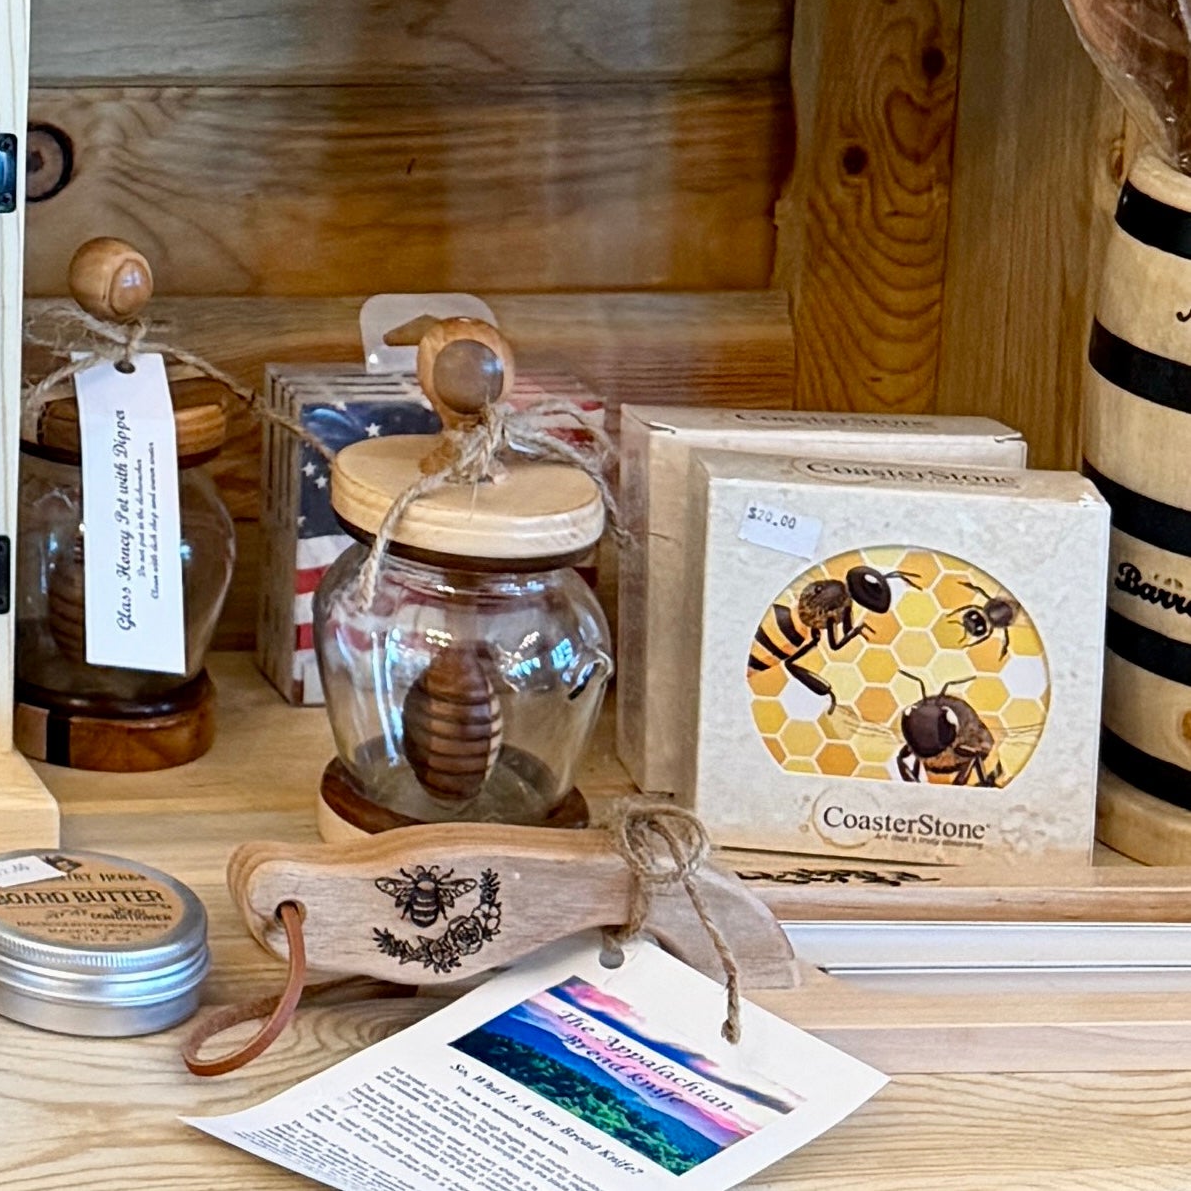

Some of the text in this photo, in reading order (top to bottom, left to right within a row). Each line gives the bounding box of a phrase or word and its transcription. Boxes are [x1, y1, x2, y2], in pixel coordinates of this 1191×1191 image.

[114, 463, 128, 494] with
[806, 462, 1018, 485] CoasterStone
[114, 498, 130, 525] Pot
[747, 506, 796, 530] $20.00
[116, 530, 134, 580] Honey
[1114, 562, 1191, 618] Barr
[116, 587, 136, 630] Glass
[822, 805, 987, 839] CoasterStone
[72, 889, 165, 904] BUTTER
[556, 1009, 734, 1114] The Appalachian
[561, 1033, 627, 1072] Bread
[473, 1075, 506, 1095] What
[560, 1127, 601, 1150] Bread
[598, 1150, 644, 1174] Knife?
